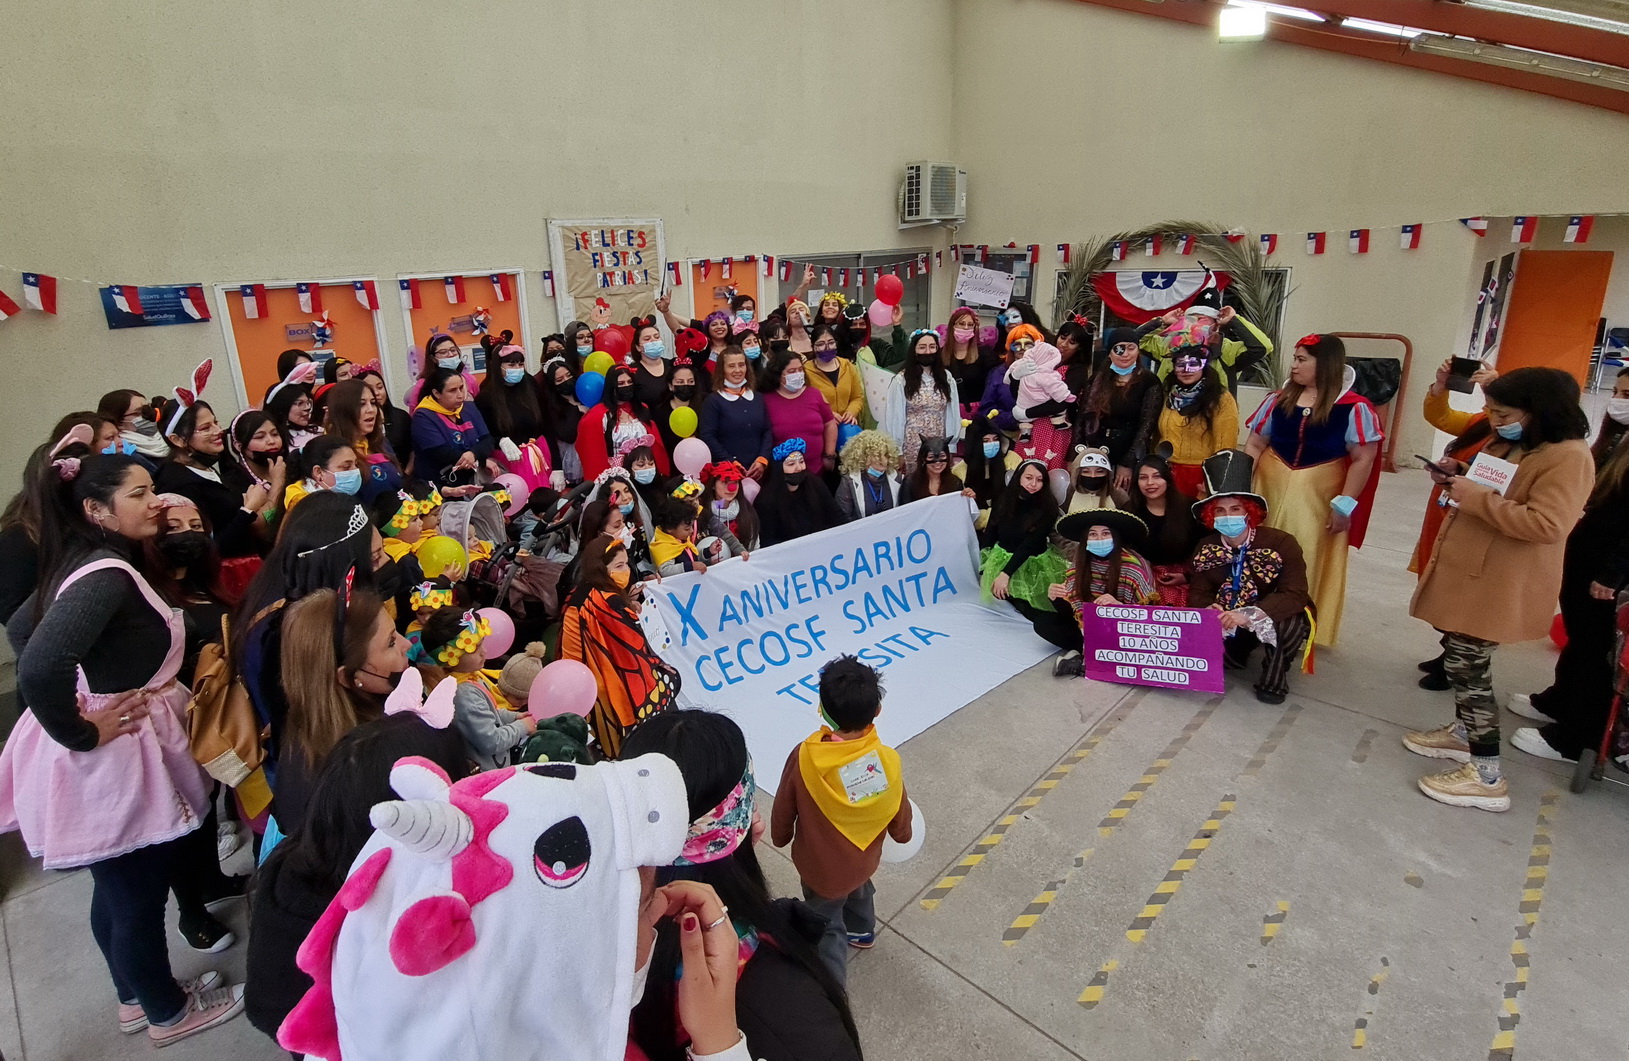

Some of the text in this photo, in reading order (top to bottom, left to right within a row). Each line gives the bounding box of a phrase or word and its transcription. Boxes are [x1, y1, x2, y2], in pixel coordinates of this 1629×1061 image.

[574, 228, 647, 251] ¡FELICES
[591, 250, 642, 268] FIESTAS
[288, 328, 310, 336] BOX
[1473, 470, 1505, 485] Saludable
[1490, 467, 1507, 479] Vida
[667, 529, 932, 647] X ANIVERSARIO
[1096, 606, 1200, 623] CECOSF SANTA
[695, 566, 958, 692] CECOSF SANTA
[1119, 623, 1180, 637] TERESITA
[1120, 636, 1177, 651] 10 AÑOS
[776, 626, 950, 705] TESITA
[1097, 650, 1207, 671] ACOMPAÑANDO
[1118, 666, 1188, 684] TU SALUD
